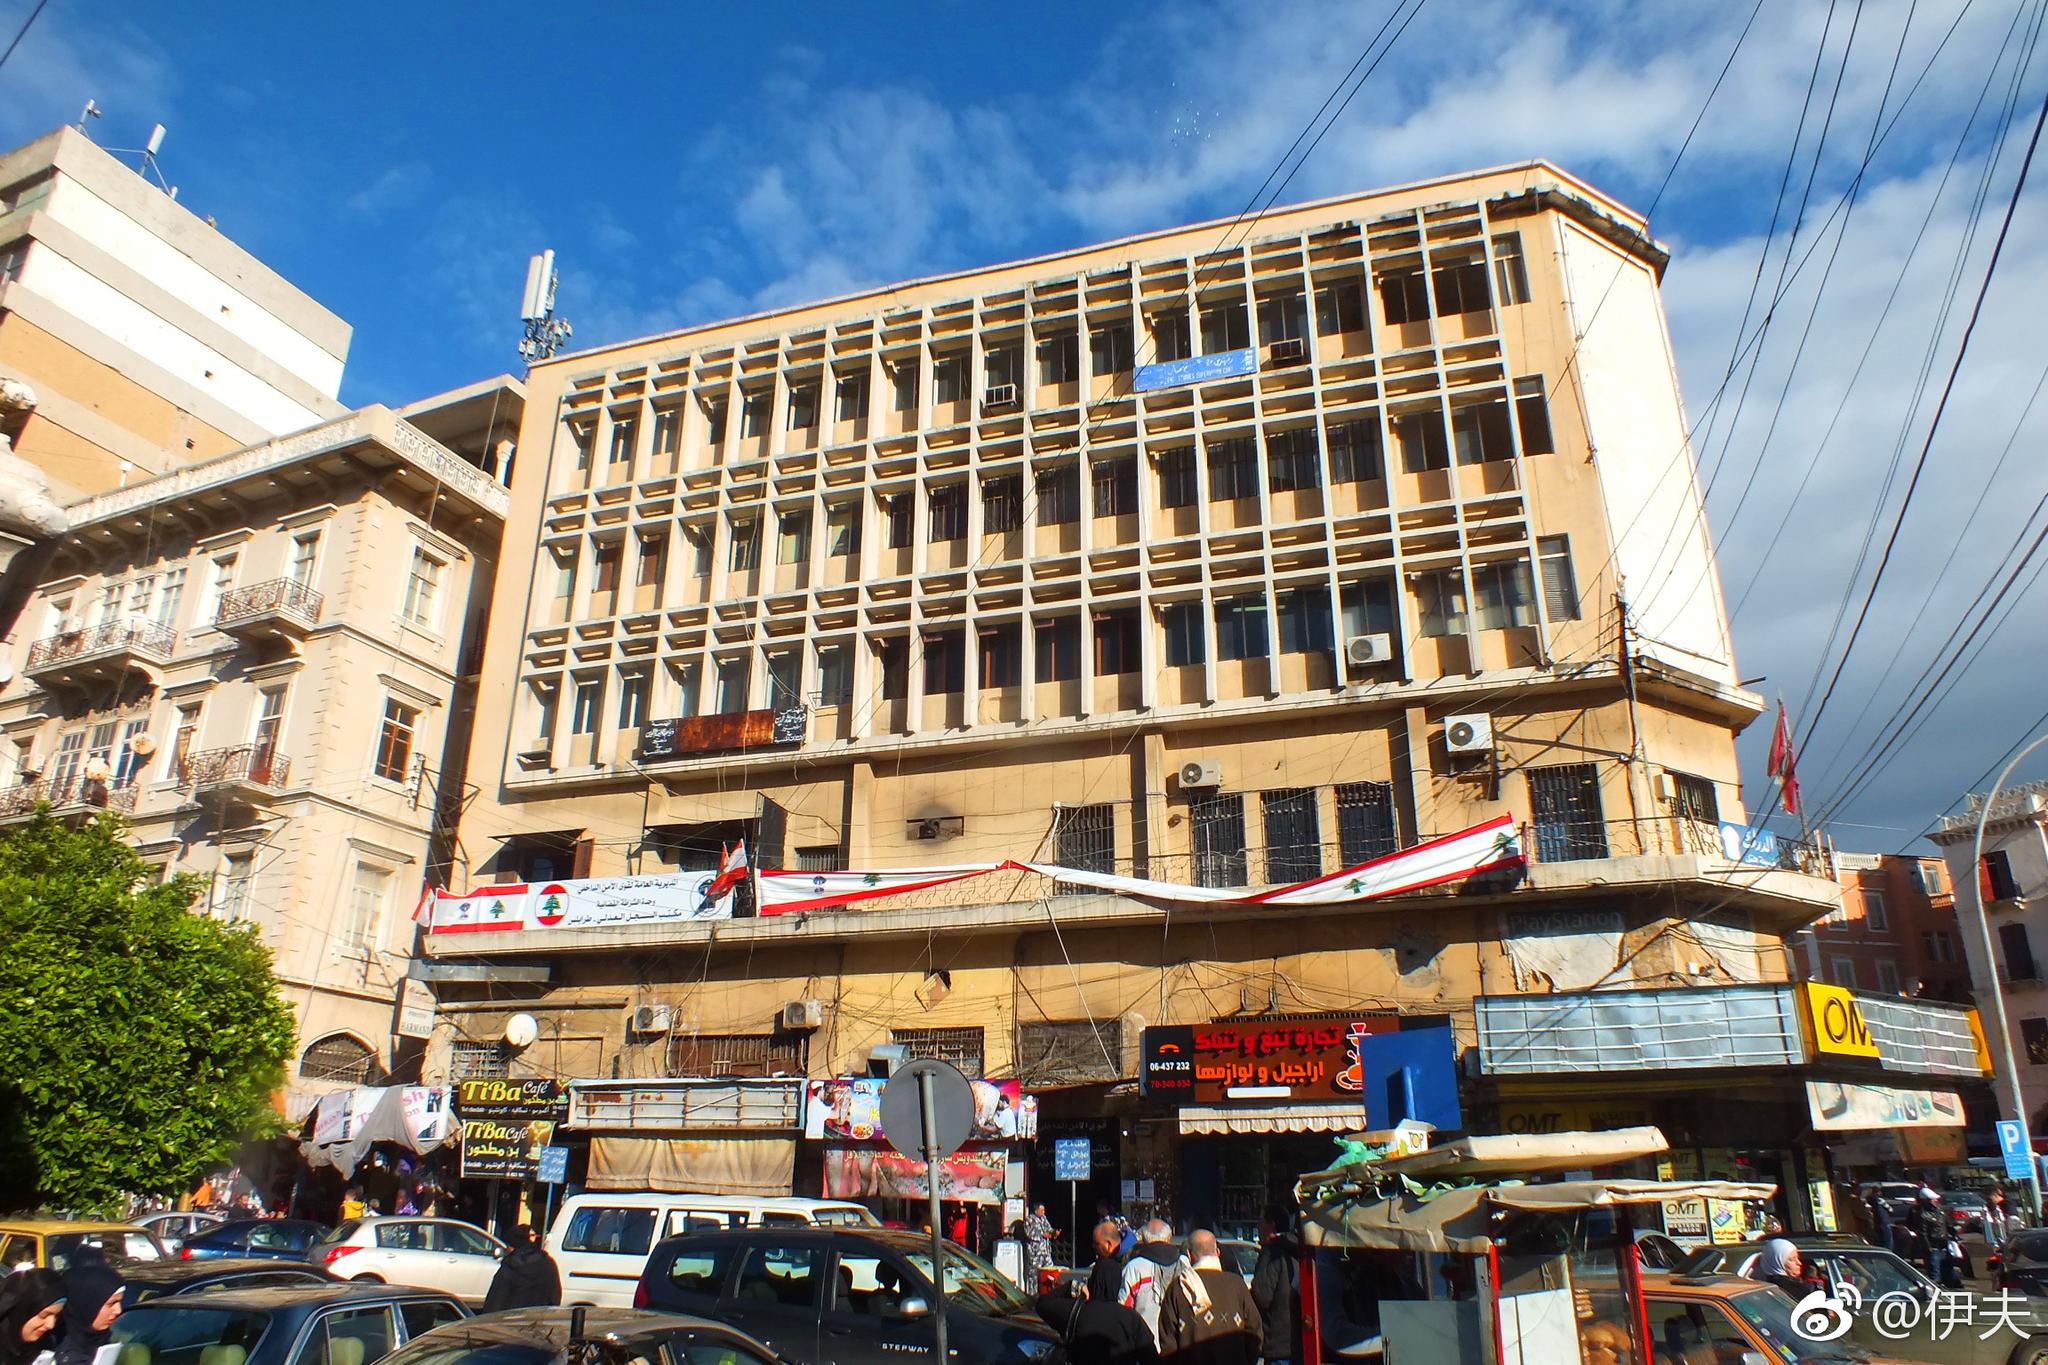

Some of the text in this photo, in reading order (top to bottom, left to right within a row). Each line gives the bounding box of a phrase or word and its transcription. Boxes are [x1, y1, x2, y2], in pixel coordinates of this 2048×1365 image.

[1510, 911, 1621, 933] PlayStation
[1260, 1030, 1291, 1054] تبغ
[1295, 1027, 1342, 1052] تجارة
[1149, 1061, 1190, 1071] 06-437 232
[462, 1080, 551, 1101] TiBa Café
[464, 1121, 529, 1143] TiBa Café
[1507, 1113, 1561, 1132] OMT
[2002, 1124, 2020, 1153] P
[466, 1142, 520, 1158] بن مطحون
[1666, 1203, 1697, 1215] OMT
[882, 1343, 929, 1353] STEPWAY
